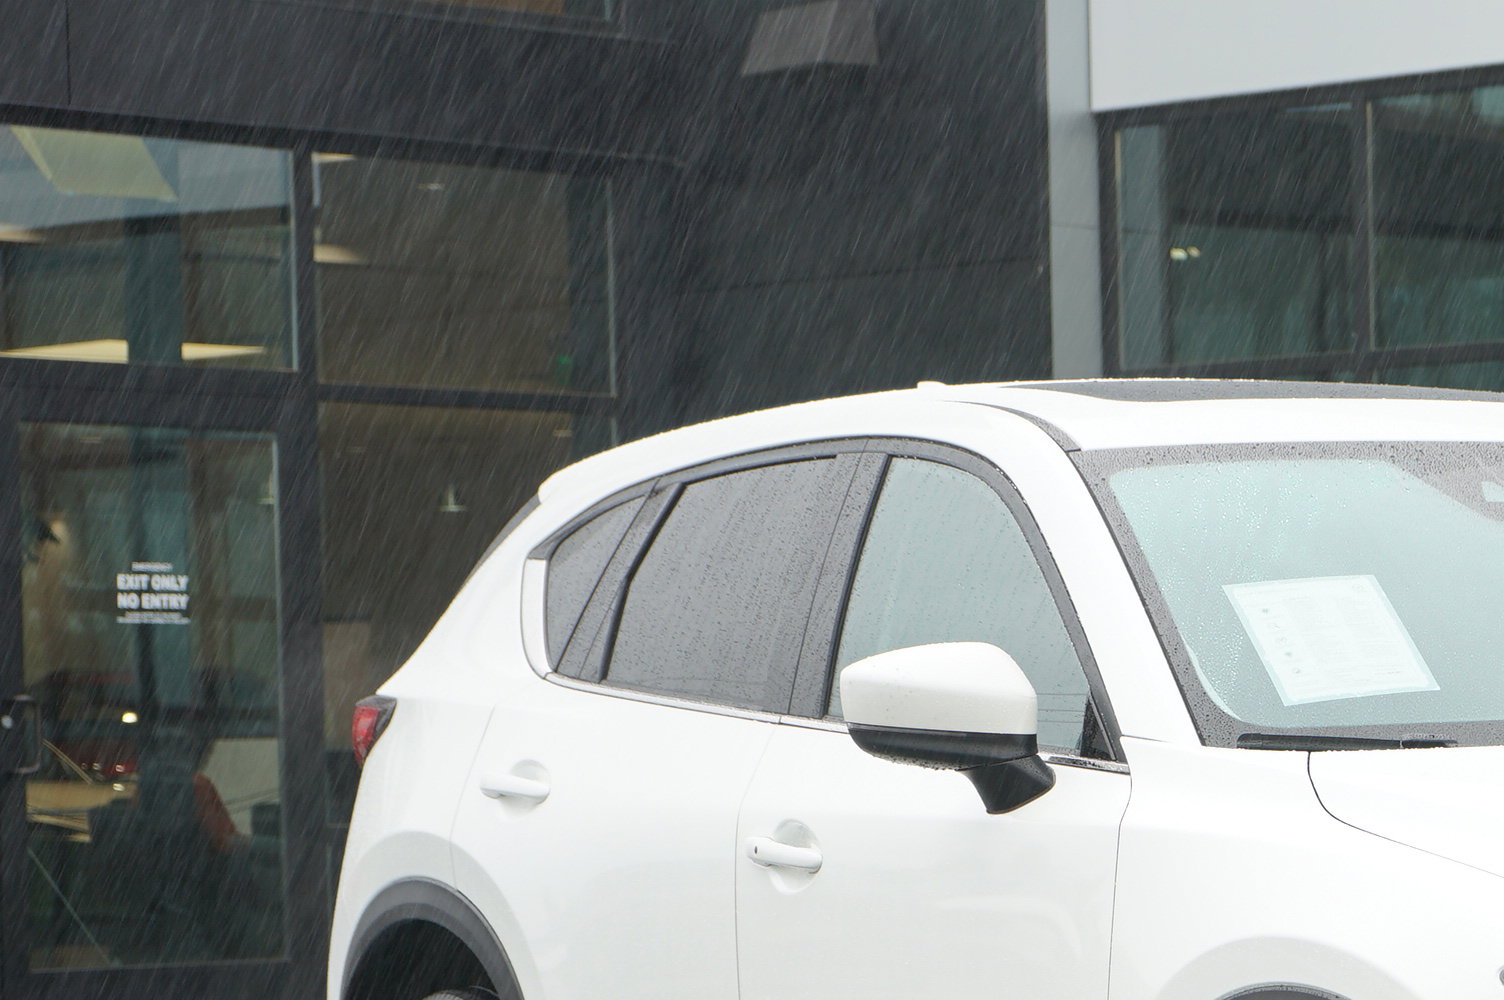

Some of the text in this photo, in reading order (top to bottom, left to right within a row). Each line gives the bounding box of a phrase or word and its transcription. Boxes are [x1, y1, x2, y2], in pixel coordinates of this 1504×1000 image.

[116, 573, 189, 592] EXIT ONLY
[116, 592, 190, 610] NO ENTRY
